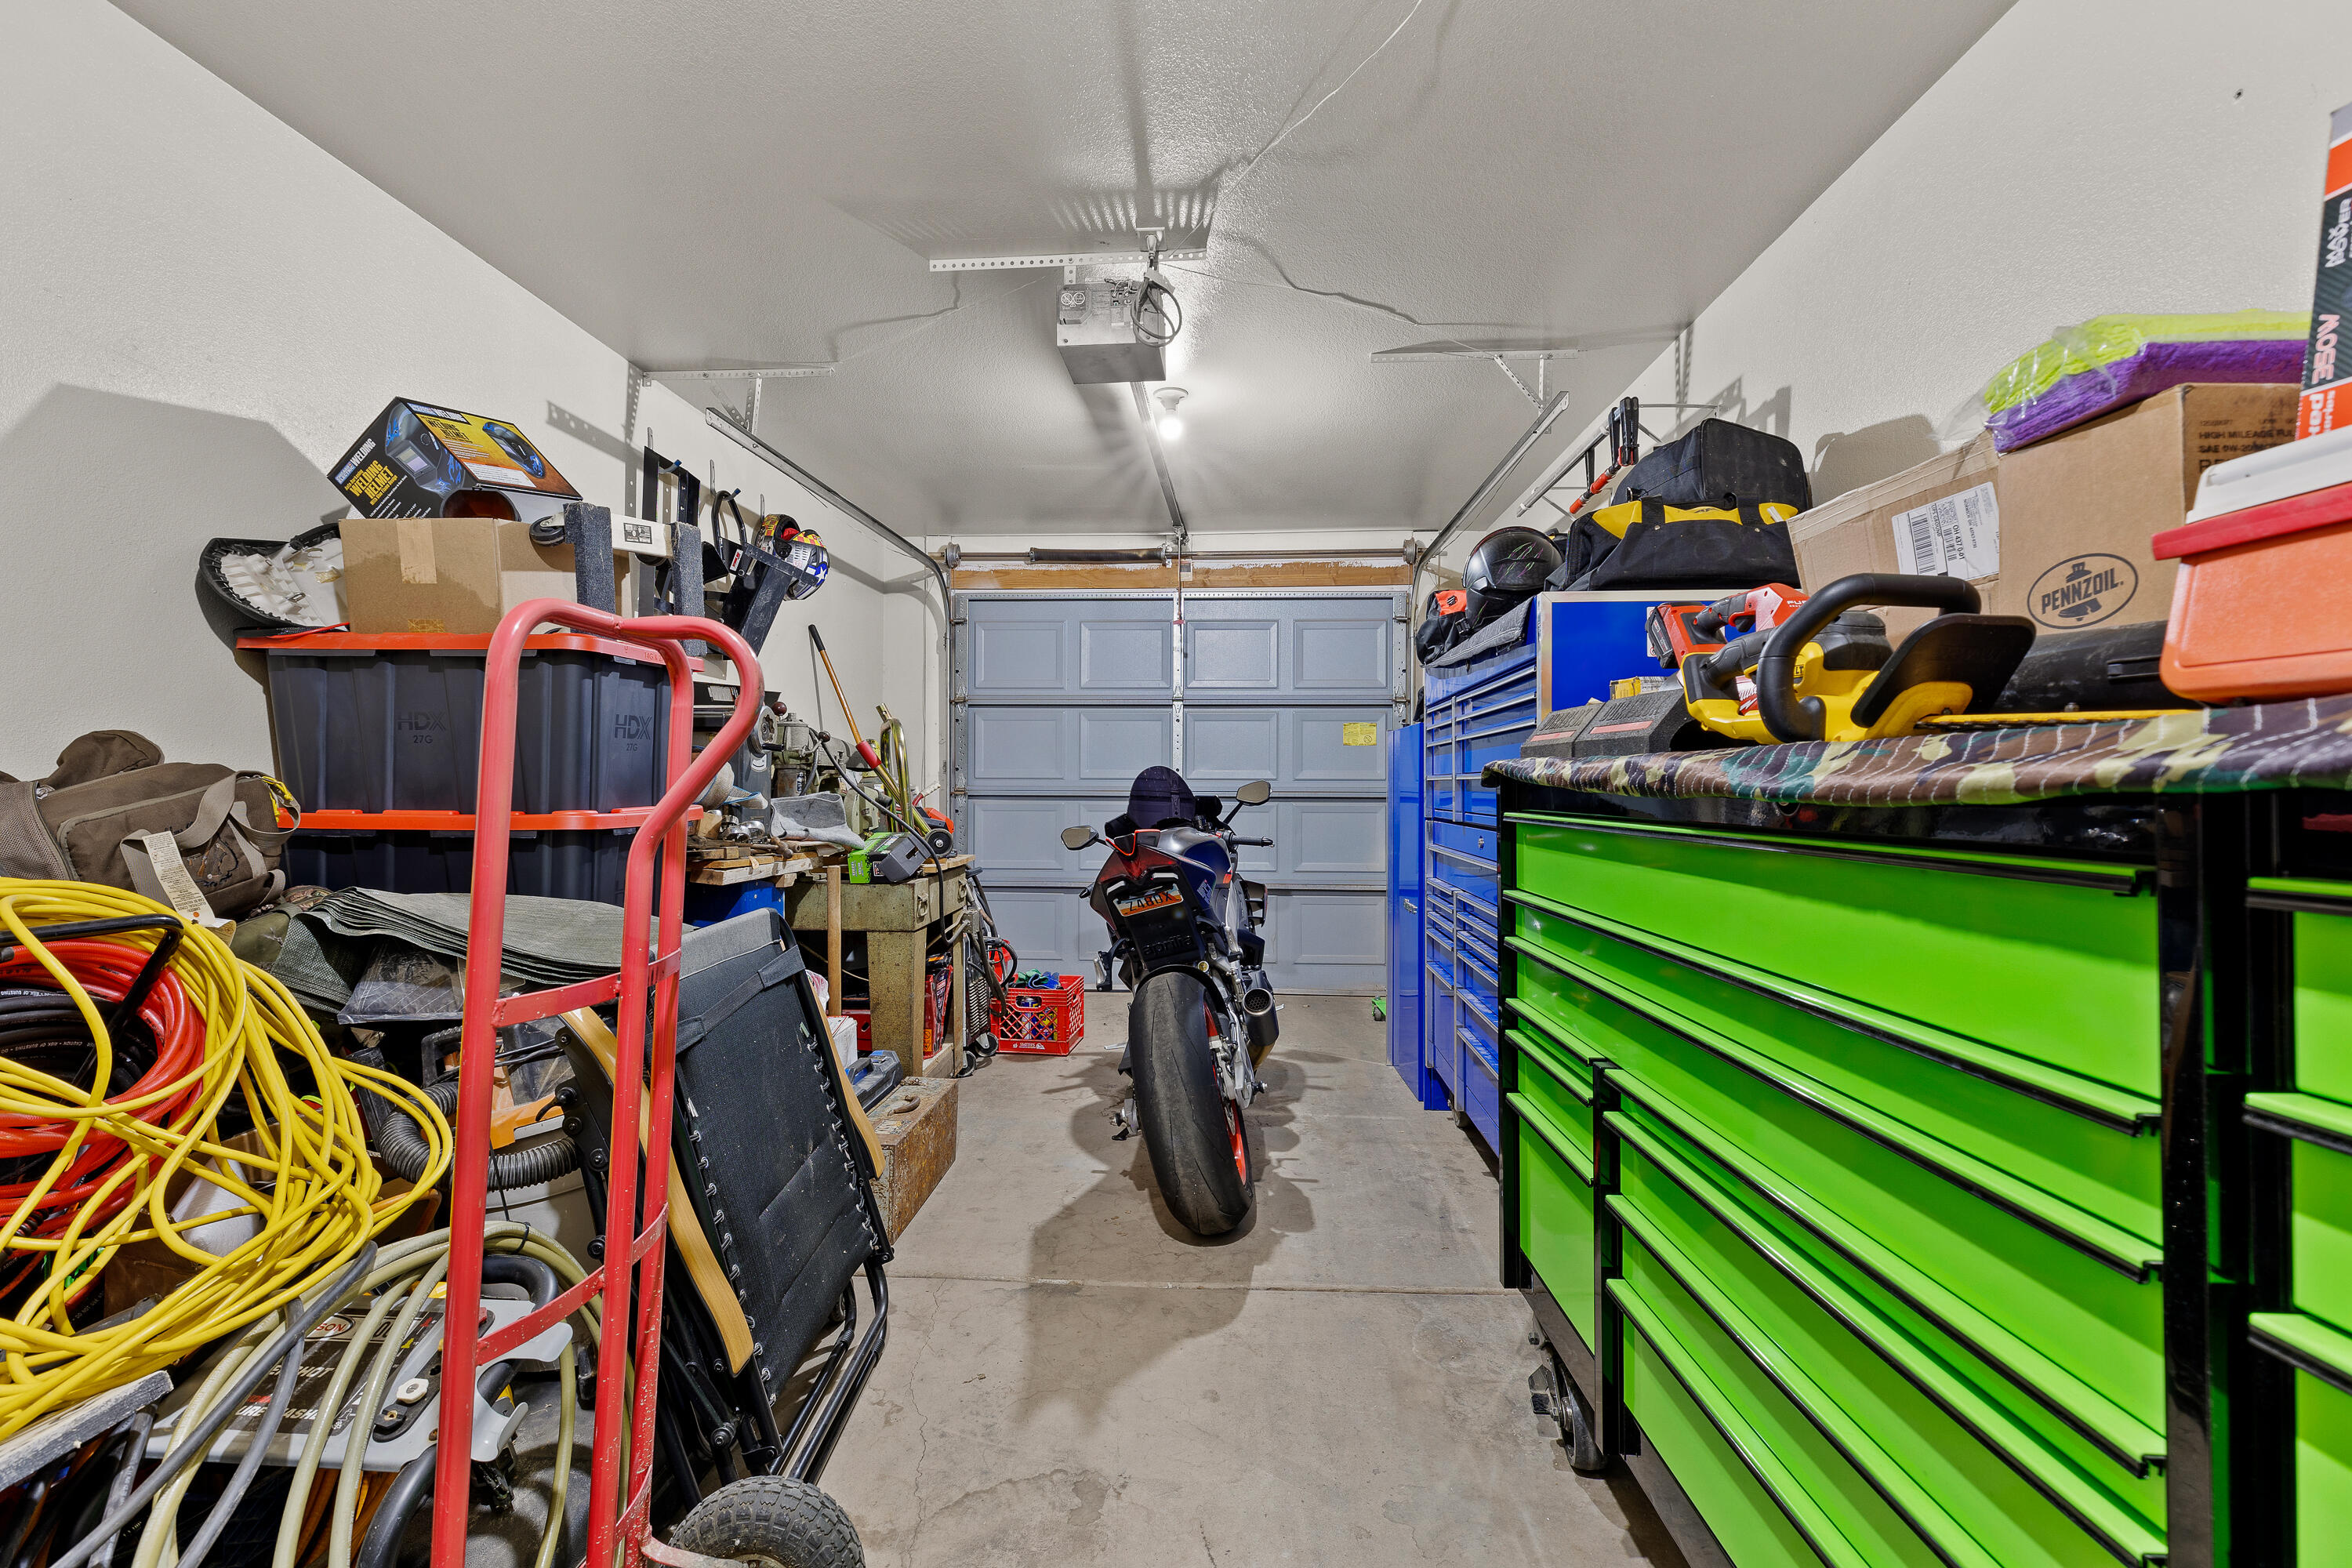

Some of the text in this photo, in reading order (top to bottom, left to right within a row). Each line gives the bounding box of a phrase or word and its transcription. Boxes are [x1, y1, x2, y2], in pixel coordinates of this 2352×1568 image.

[2228, 430, 2274, 438] MILEAGE
[350, 437, 376, 466] WELDING
[349, 459, 384, 497] WELDING
[364, 465, 394, 499] HELMET
[1952, 524, 1960, 535] OH
[2042, 568, 2119, 615] PENNZOIL
[397, 711, 445, 731] HDX
[615, 714, 652, 739] HDX
[413, 735, 433, 744] 27G
[626, 743, 638, 752] 27G
[1143, 935, 1192, 954] aprilia
